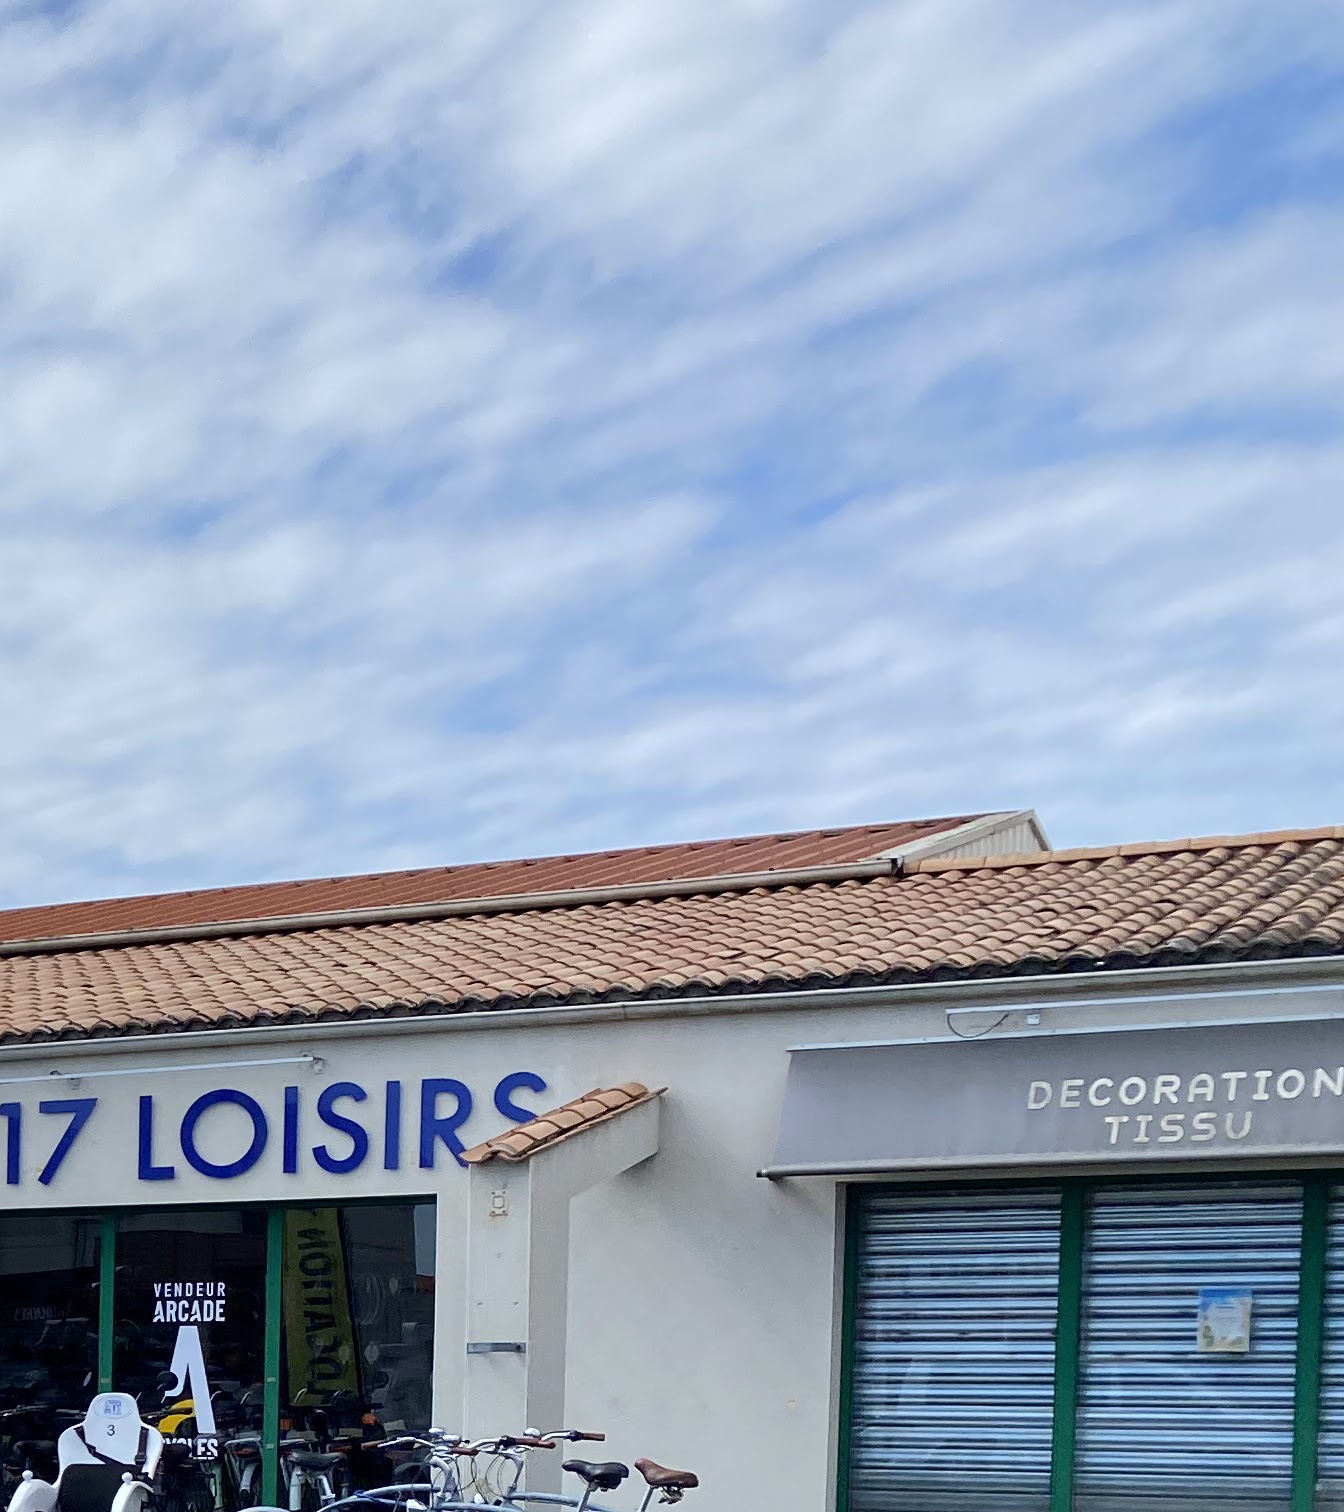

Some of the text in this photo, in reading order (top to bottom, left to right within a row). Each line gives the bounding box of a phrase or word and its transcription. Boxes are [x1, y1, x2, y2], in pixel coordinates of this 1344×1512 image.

[1026, 1065, 1344, 1110] DECORATION
[1104, 1110, 1253, 1145] TISSU
[153, 1281, 226, 1298] VENDEUR
[152, 1299, 226, 1323] ARCADE
[106, 1424, 116, 1437] 3
